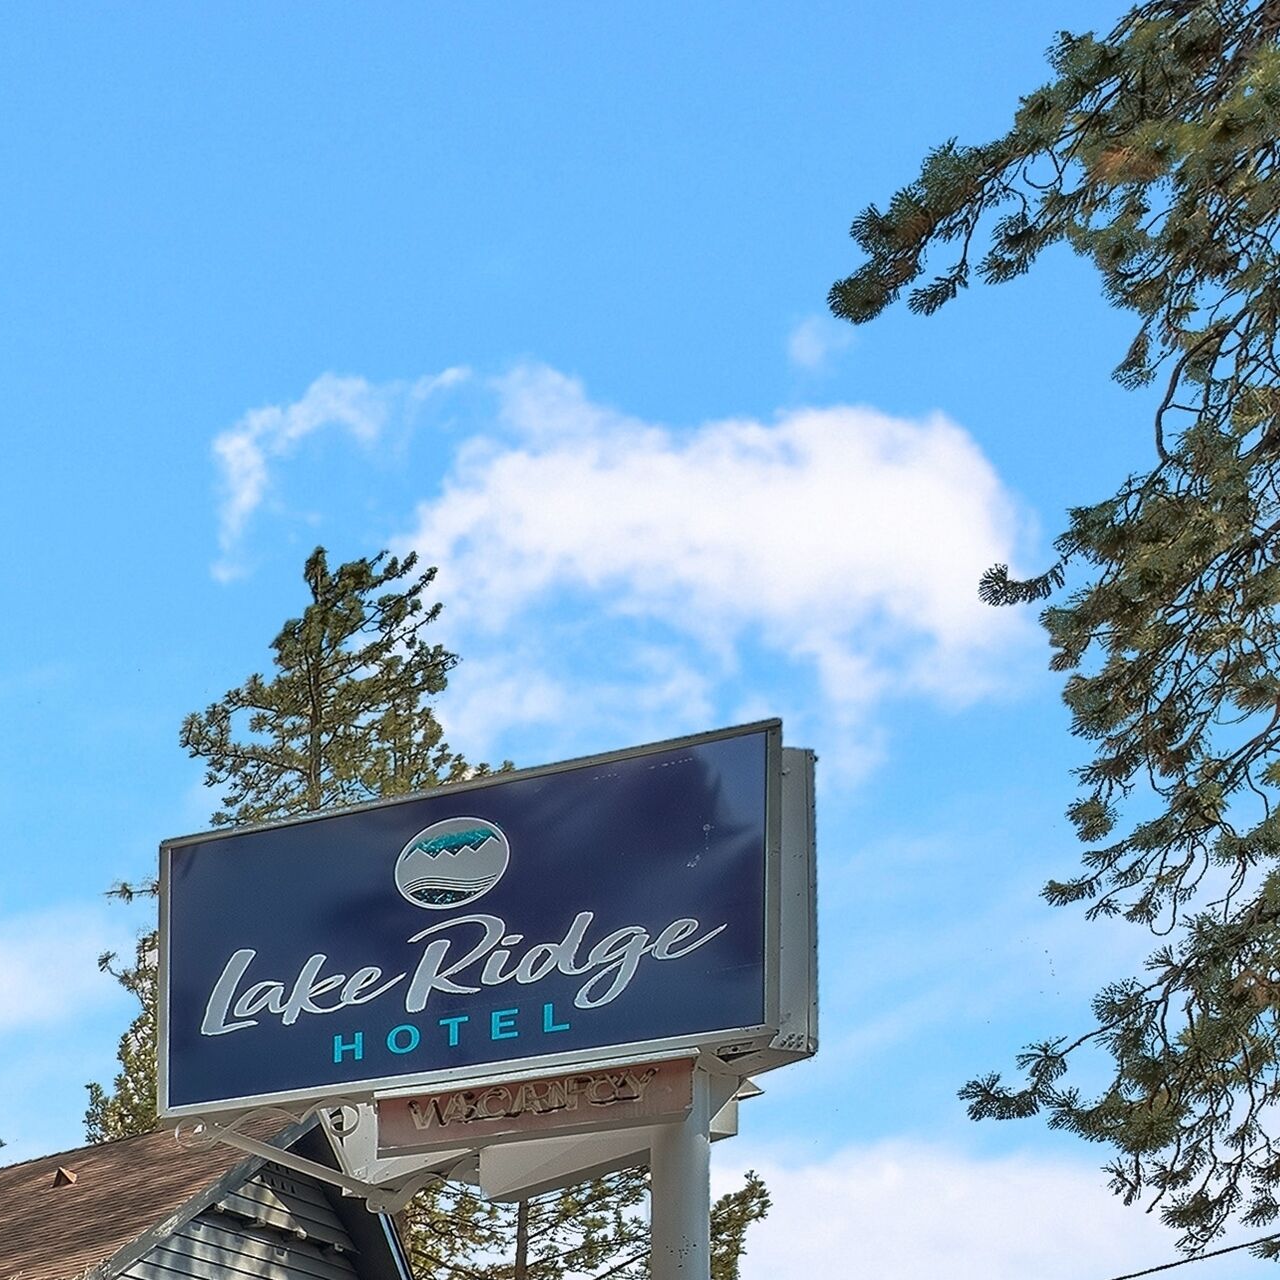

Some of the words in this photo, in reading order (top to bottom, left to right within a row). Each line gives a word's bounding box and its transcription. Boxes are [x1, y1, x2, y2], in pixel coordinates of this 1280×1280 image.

[201, 948, 407, 1035] Lake
[406, 911, 727, 1012] Ridge
[332, 1003, 570, 1063] HOTEL
